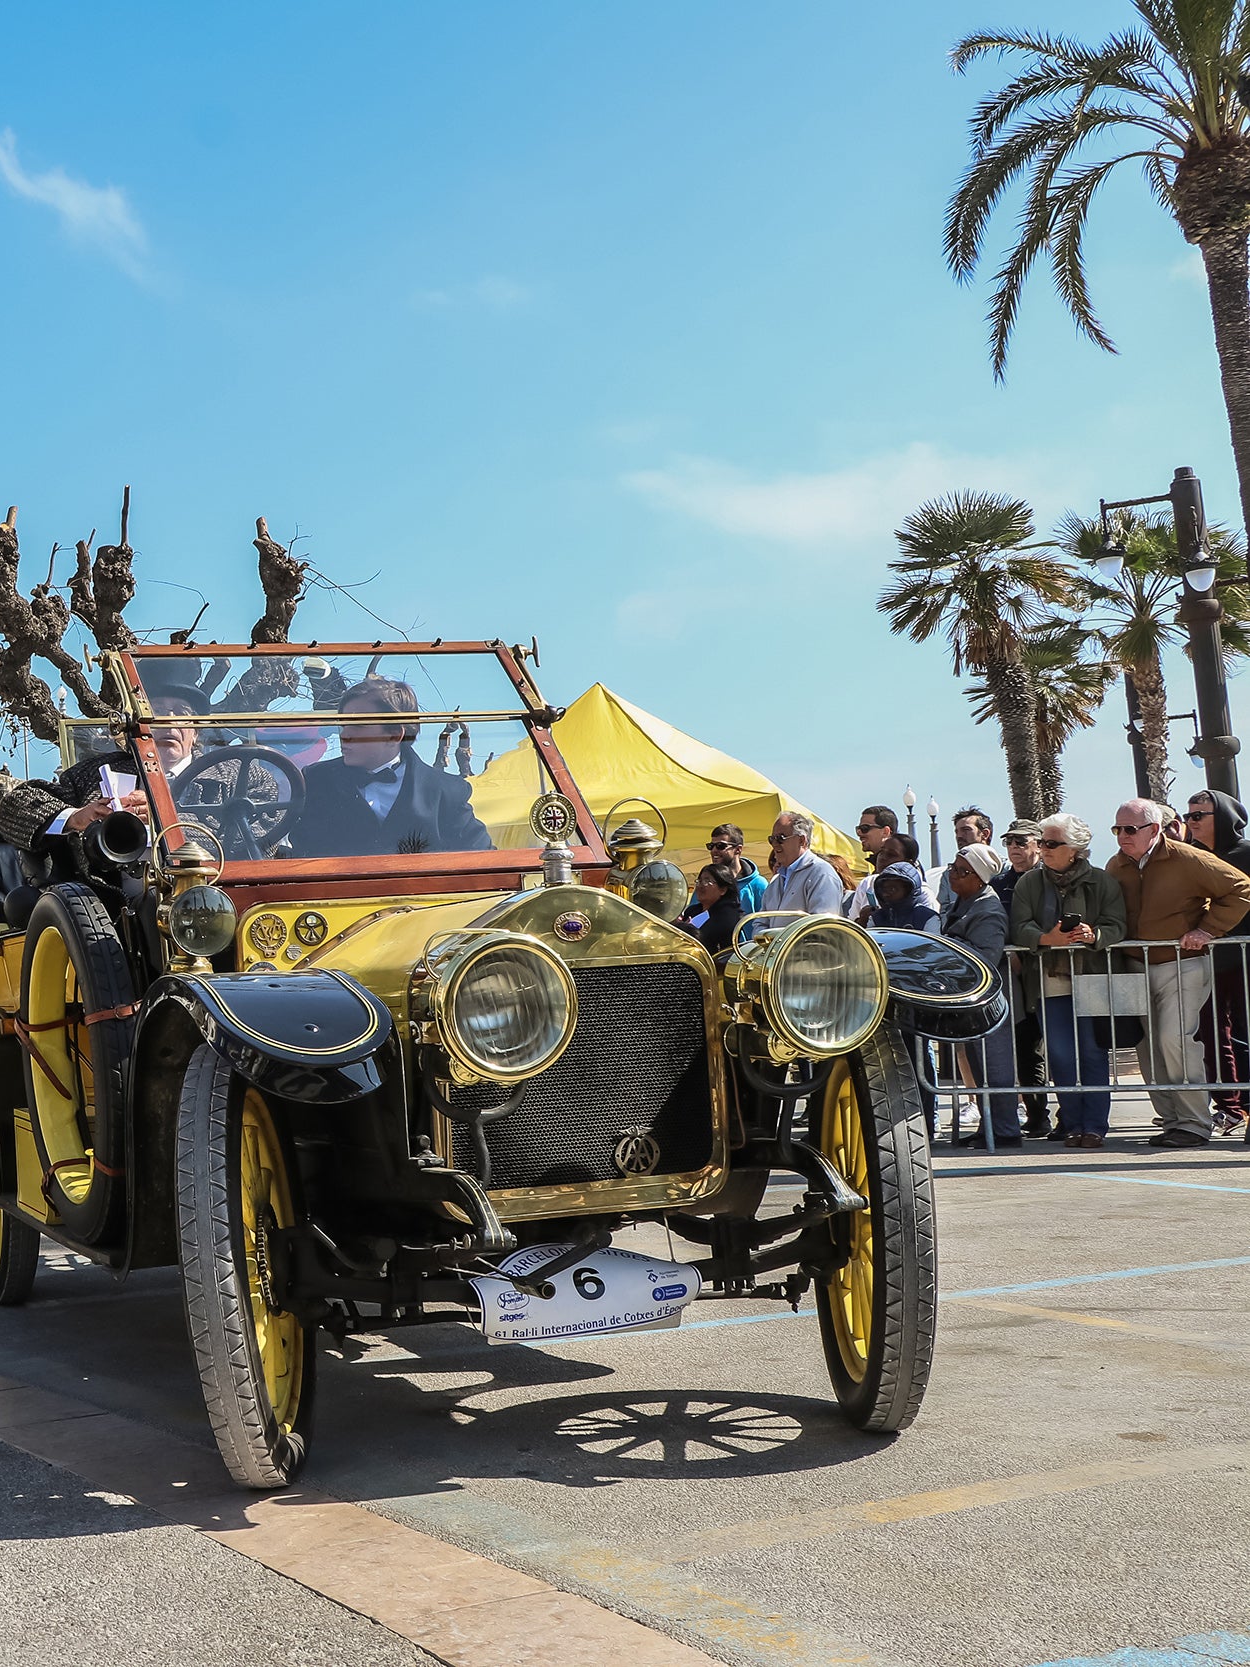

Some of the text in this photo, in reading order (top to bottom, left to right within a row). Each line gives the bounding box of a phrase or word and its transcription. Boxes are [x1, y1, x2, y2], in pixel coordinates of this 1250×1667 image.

[506, 1246, 570, 1278] BARCELON
[572, 1267, 606, 1300] 6
[499, 1313, 525, 1322] sitges
[541, 1317, 607, 1336] Internacional
[610, 1315, 622, 1325] de
[624, 1310, 655, 1322] Cotxes
